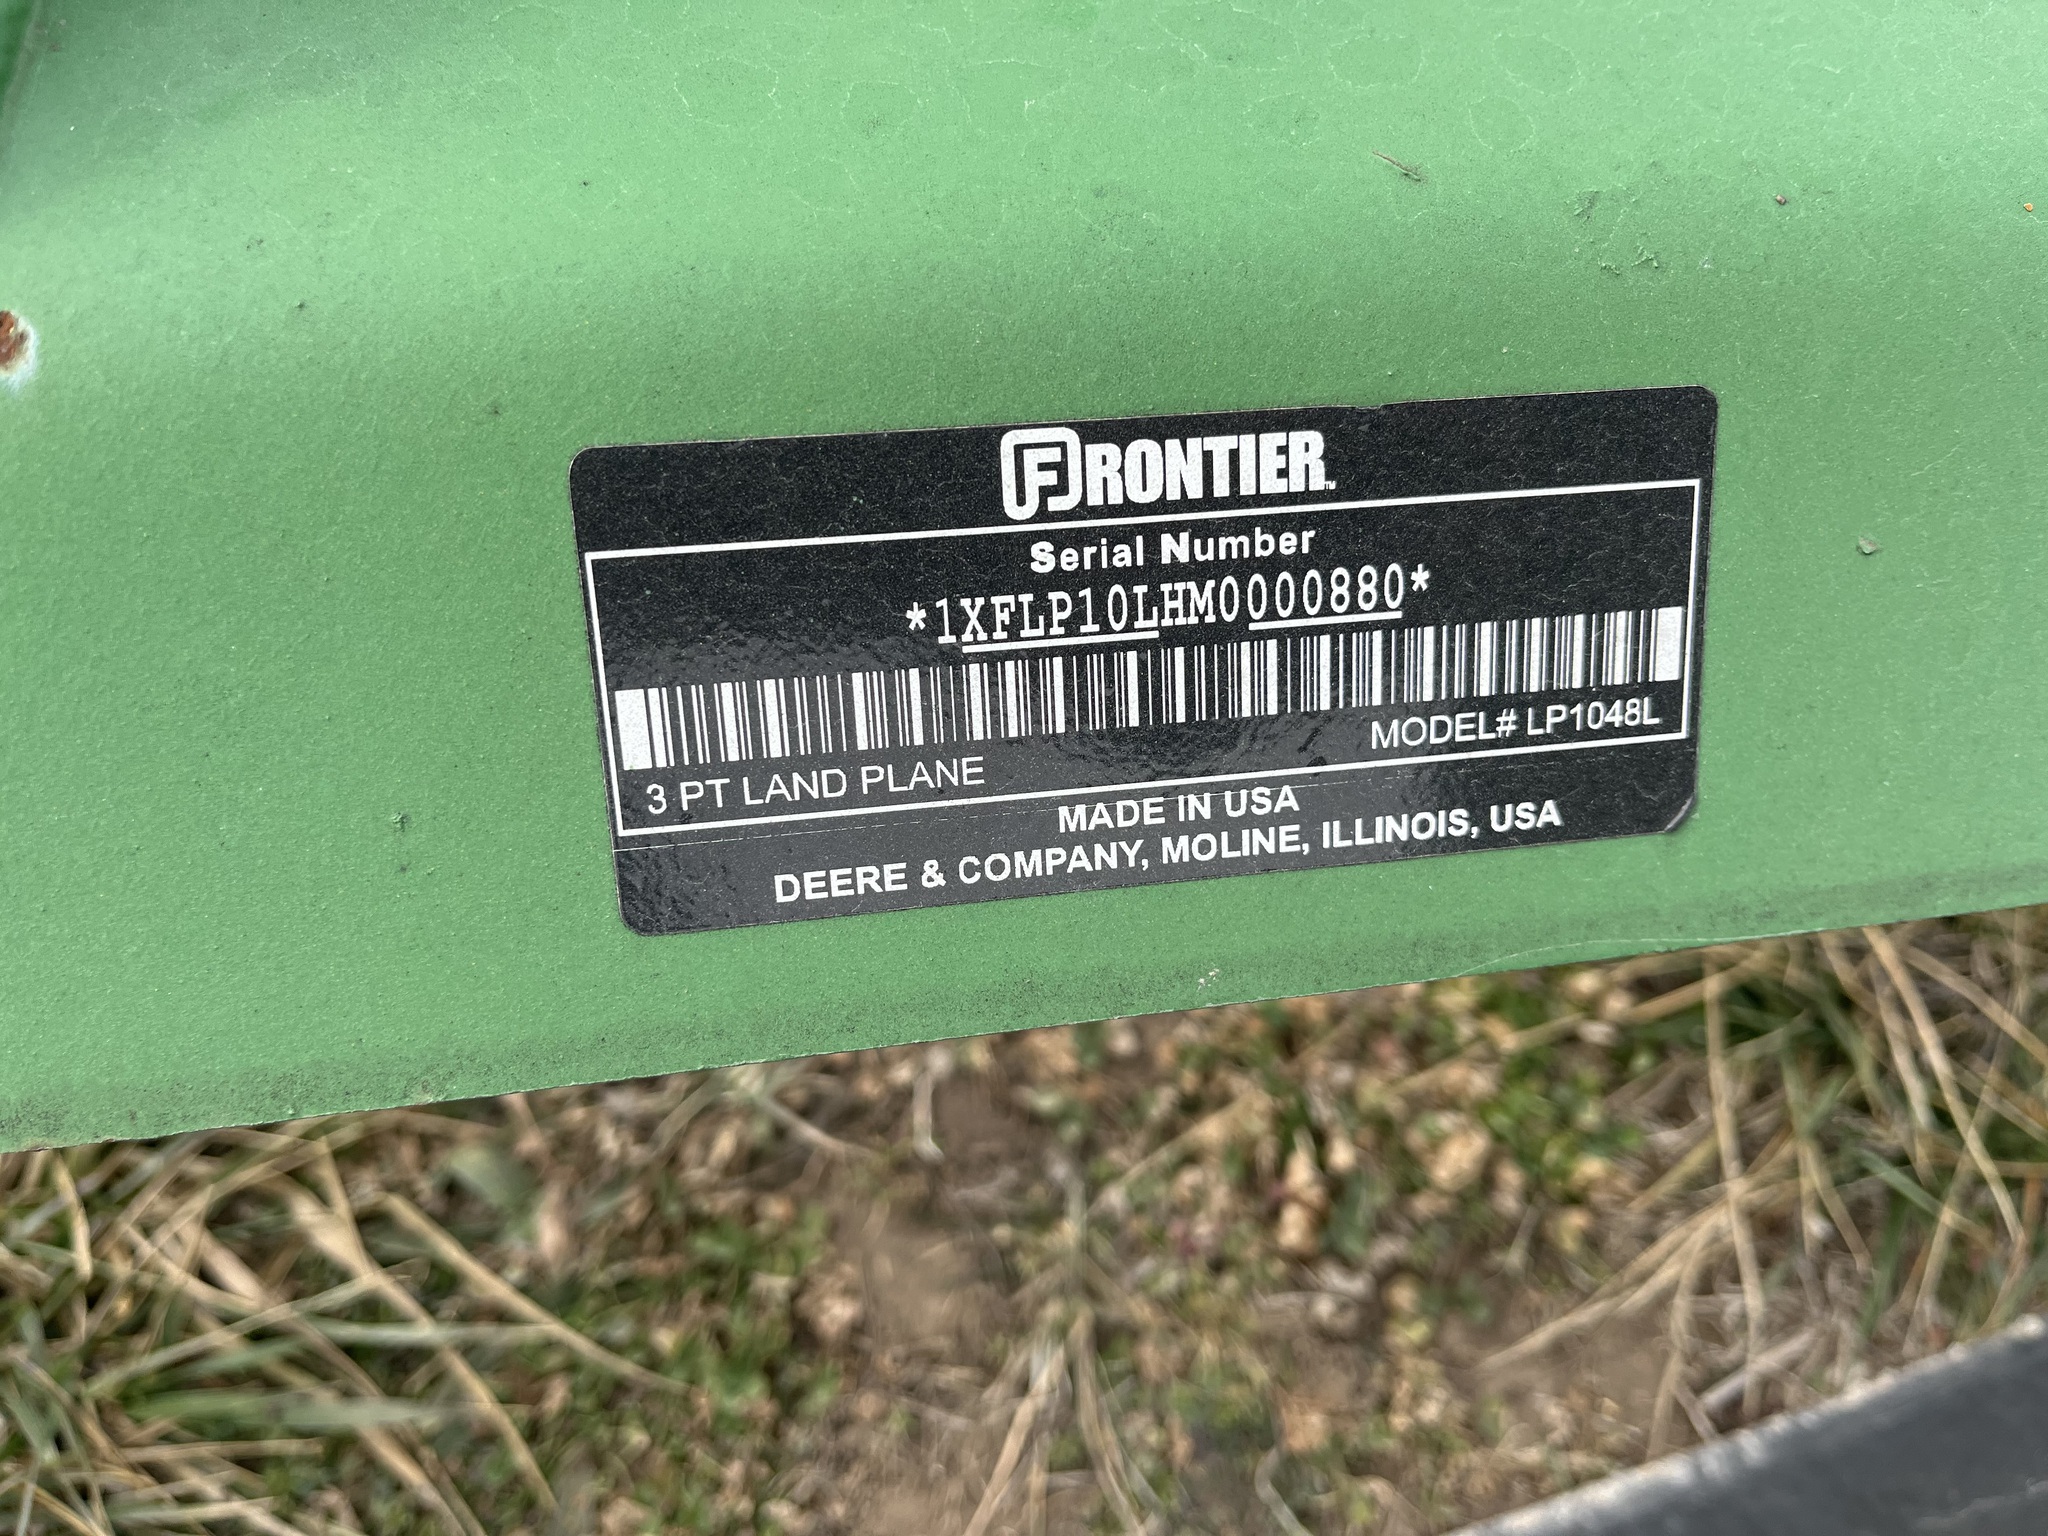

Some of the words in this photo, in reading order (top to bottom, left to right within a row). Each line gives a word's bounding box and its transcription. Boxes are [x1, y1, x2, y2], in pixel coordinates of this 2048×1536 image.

[1001, 427, 1325, 520] FRONTIER
[1030, 535, 1144, 573] Serial
[1160, 528, 1315, 564] Number
[1371, 710, 1517, 750] MODEL#
[1527, 697, 1660, 736] LP1048L
[646, 784, 668, 815] 3
[680, 778, 730, 809] PT
[742, 768, 848, 806] LAND
[861, 756, 985, 795] PLANE
[1058, 798, 1164, 833] MADE
[1178, 795, 1212, 822] IN
[1224, 786, 1300, 818] USA
[775, 863, 907, 903] DEERE
[921, 860, 946, 888] &
[958, 840, 1149, 885] COMPANY,
[1162, 824, 1310, 864] MOLINE,
[1322, 808, 1480, 849] ILLINOIS,
[1490, 799, 1562, 832] USA
